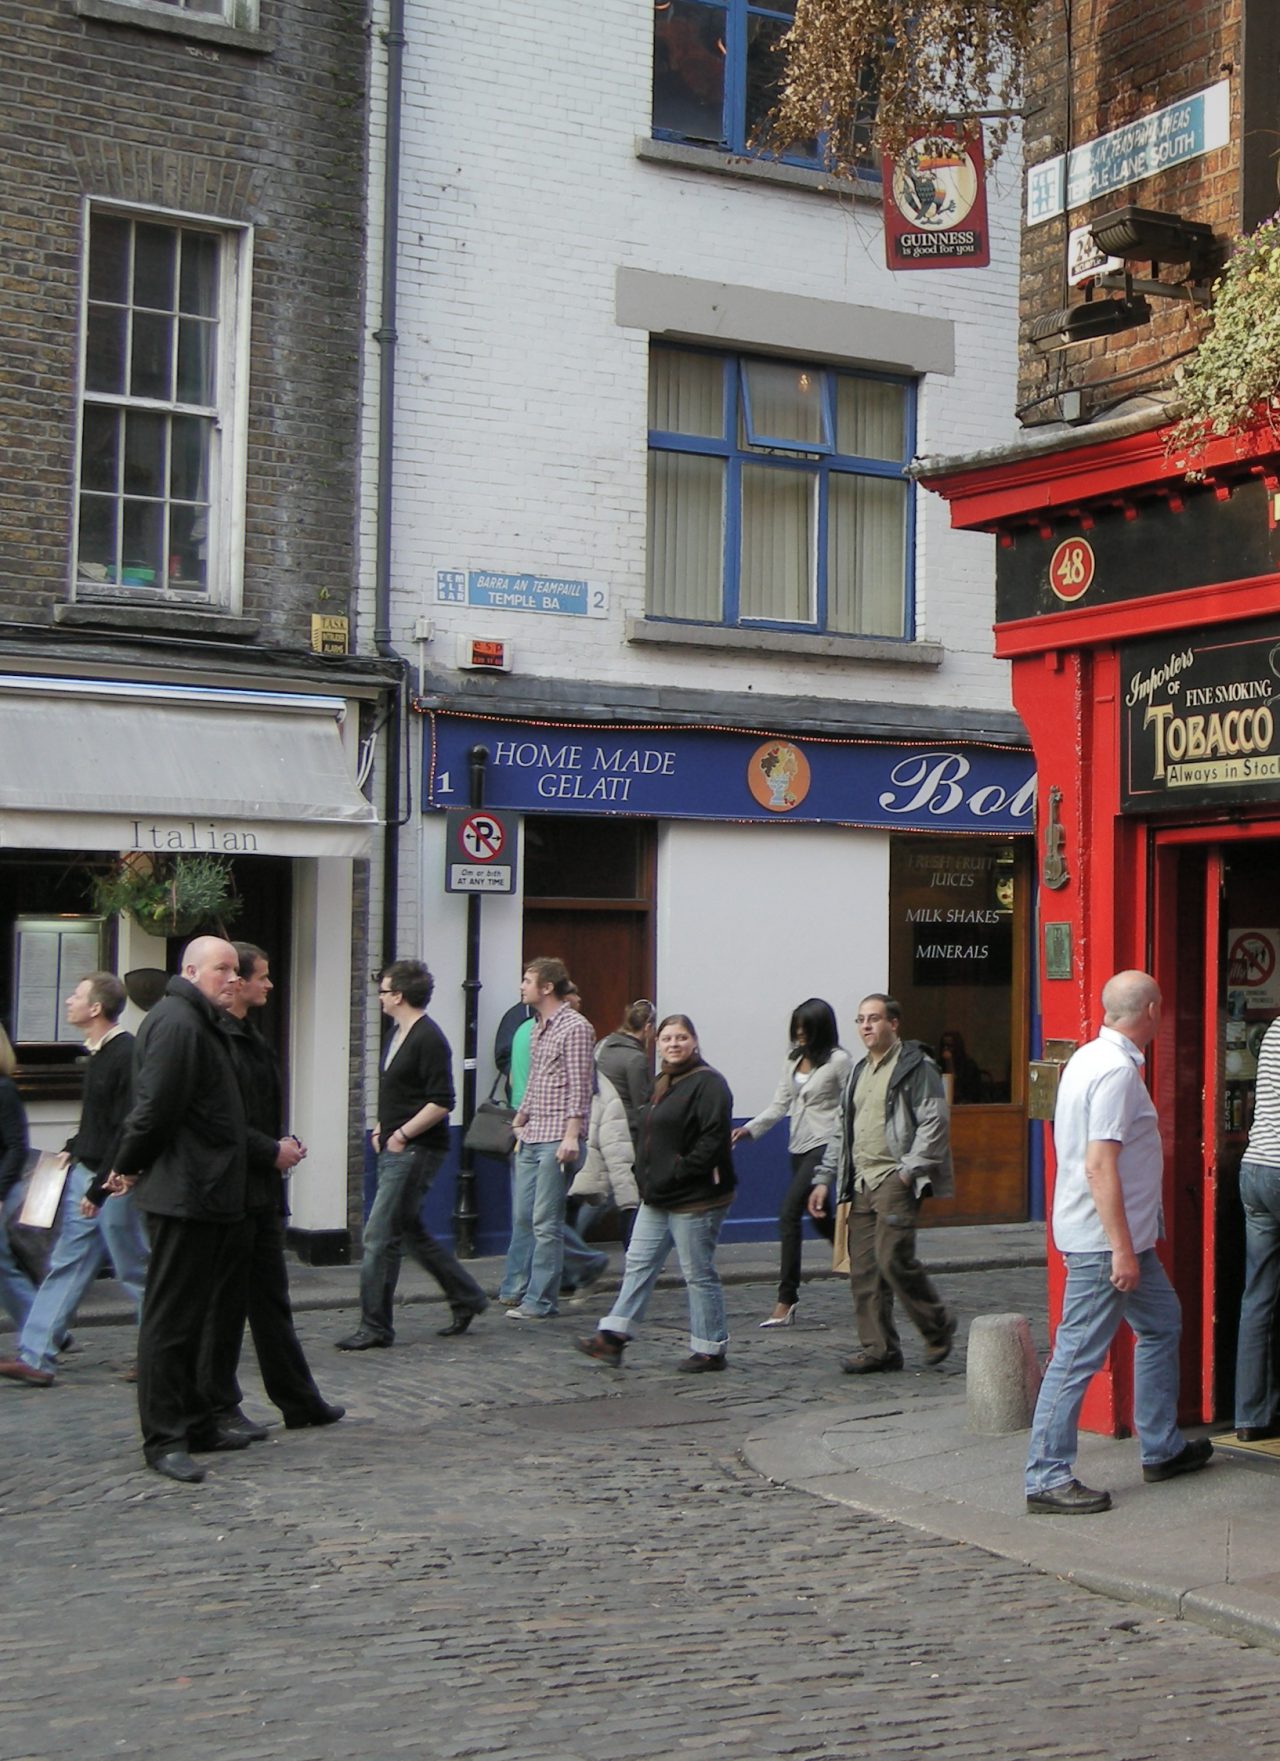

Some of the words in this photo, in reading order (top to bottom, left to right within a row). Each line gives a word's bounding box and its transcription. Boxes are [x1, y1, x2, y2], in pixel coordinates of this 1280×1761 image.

[1113, 154, 1146, 181] LANE
[1151, 130, 1195, 167] SOUTH
[901, 231, 974, 247] GUINNESS
[902, 246, 911, 255] is
[913, 245, 938, 258] good
[939, 244, 955, 254] for
[956, 245, 975, 256] you
[1056, 548, 1085, 586] 48
[438, 573, 465, 583] TEM
[438, 582, 465, 592] PLE
[476, 575, 509, 591] BARRA
[513, 579, 529, 591] AN
[532, 580, 582, 597] TEAMPAILL
[488, 591, 537, 608] TEMPLE
[593, 591, 605, 609] 2
[1125, 648, 1194, 708] Importers
[1167, 681, 1181, 695] OF
[1185, 688, 1214, 708] FINE
[1214, 679, 1272, 704] SMOKING
[1142, 703, 1274, 782] TOBACCO
[493, 742, 583, 770] HOME
[591, 747, 676, 775] MADE
[437, 771, 454, 793] 1
[1169, 764, 1218, 784] Always
[1225, 762, 1237, 778] in
[537, 774, 632, 801] GELATI
[130, 821, 259, 851] Italian
[955, 857, 995, 871] FRUIT
[457, 877, 467, 885] AT
[469, 877, 486, 885] ANY
[488, 878, 505, 887] TIME
[930, 873, 975, 888] JUICES
[905, 909, 943, 923] MILK
[946, 909, 1000, 924] SHAKES
[916, 944, 989, 959] MINERALS
